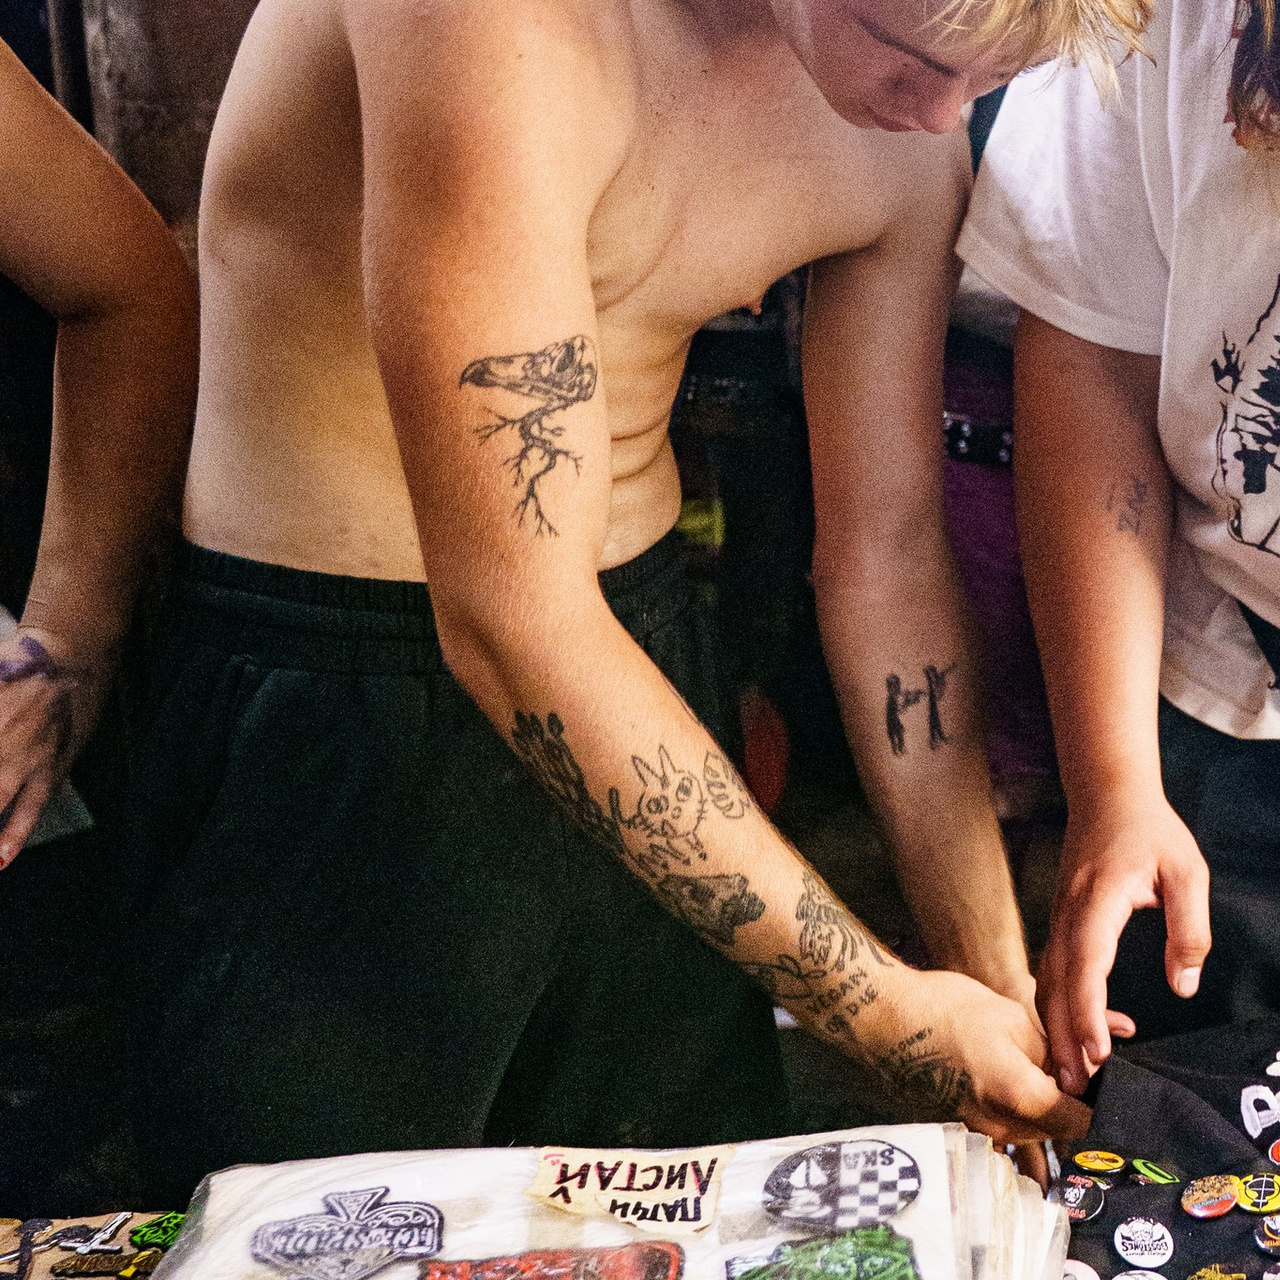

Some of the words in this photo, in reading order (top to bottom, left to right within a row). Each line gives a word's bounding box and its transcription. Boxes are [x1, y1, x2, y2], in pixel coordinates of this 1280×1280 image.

[841, 1147, 894, 1170] SKA
[549, 1157, 719, 1205] ЛИСТАЙ
[608, 1196, 701, 1222] ПАТЧИ
